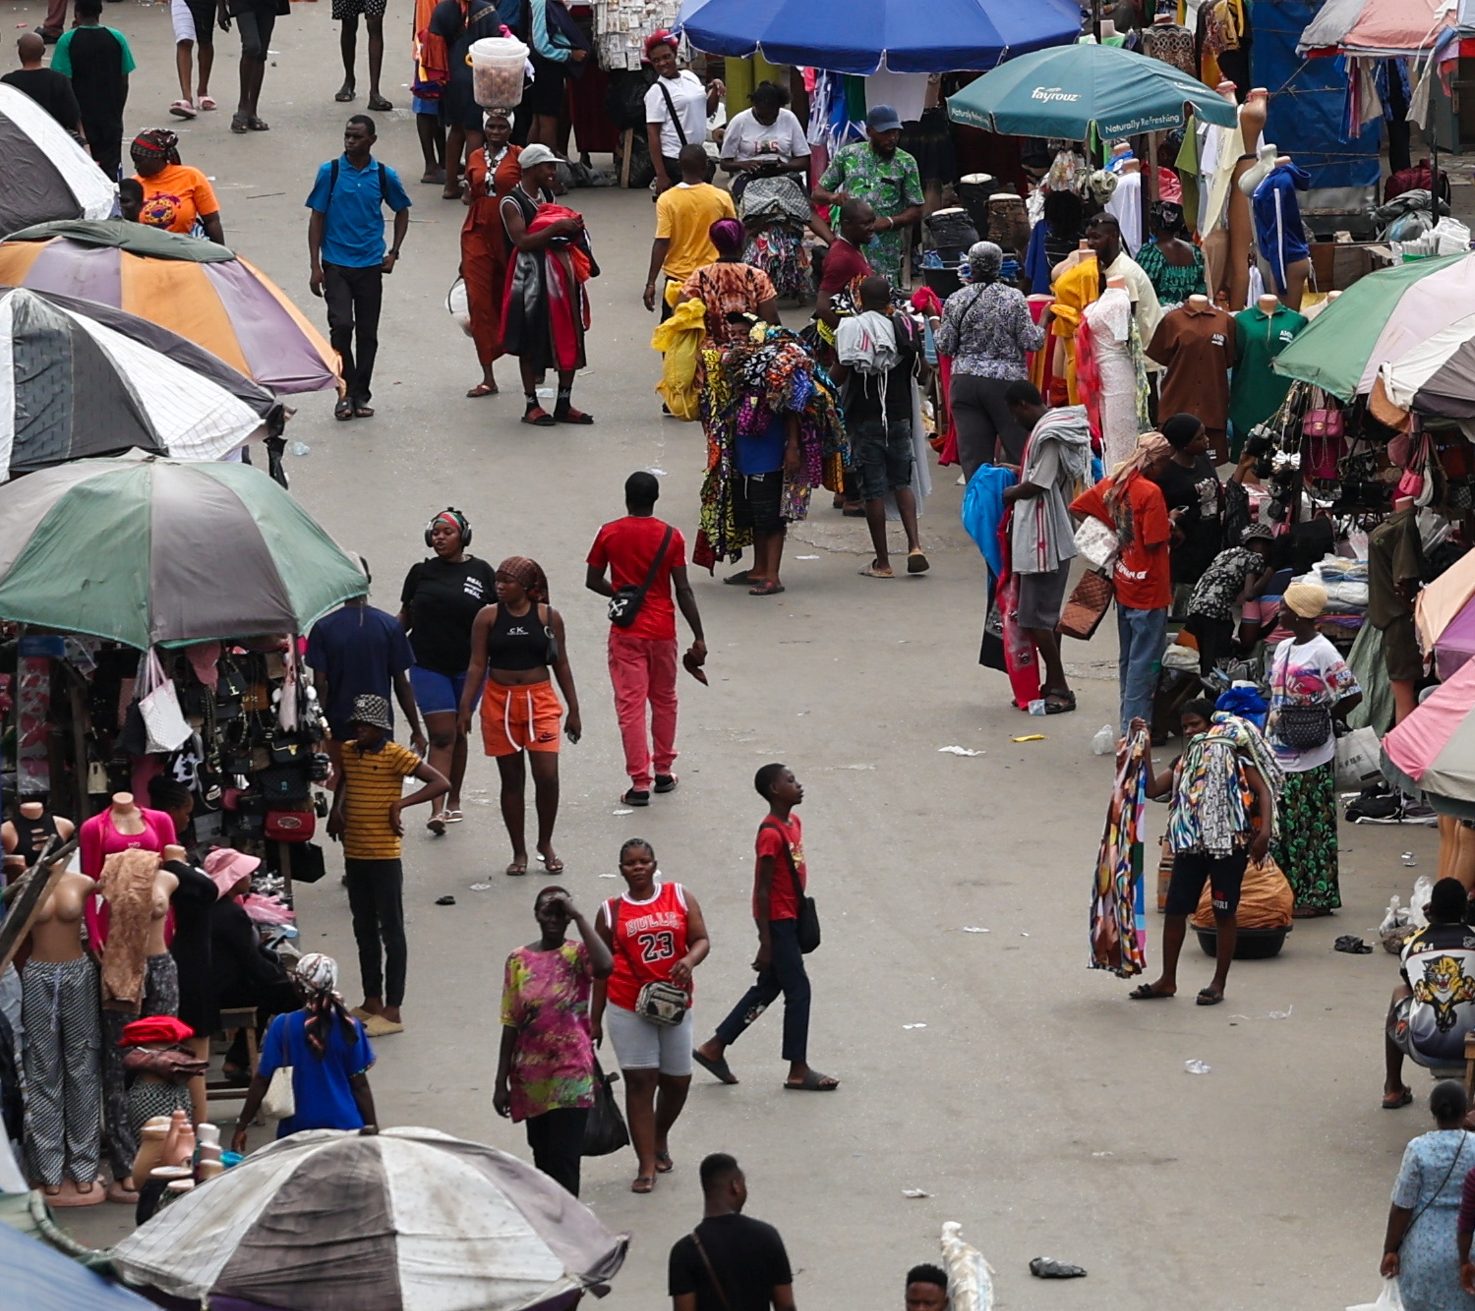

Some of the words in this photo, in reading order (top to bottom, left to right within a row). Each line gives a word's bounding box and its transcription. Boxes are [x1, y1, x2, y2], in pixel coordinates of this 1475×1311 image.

[1032, 87, 1078, 103] fayrouz
[1105, 120, 1140, 134] Naturally
[1141, 113, 1180, 129] Refreshing
[638, 931, 674, 964] 23
